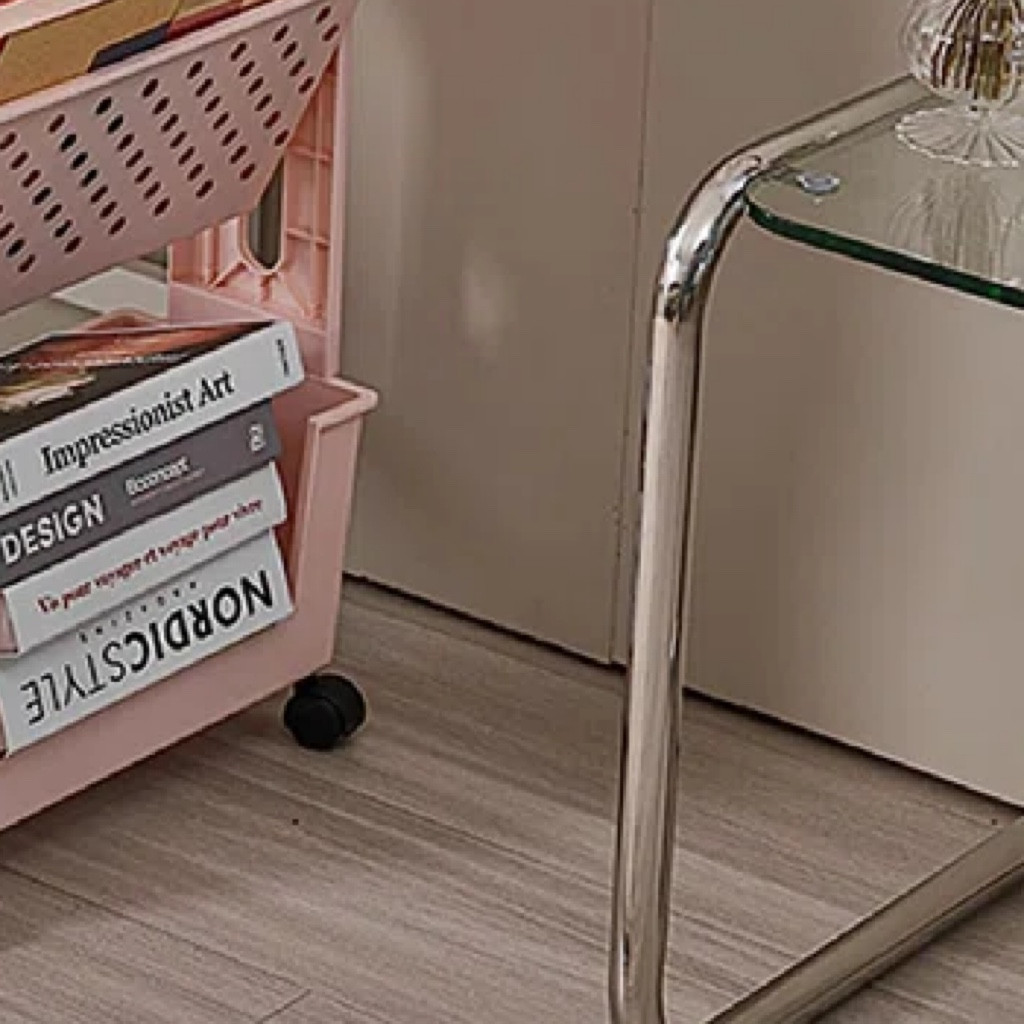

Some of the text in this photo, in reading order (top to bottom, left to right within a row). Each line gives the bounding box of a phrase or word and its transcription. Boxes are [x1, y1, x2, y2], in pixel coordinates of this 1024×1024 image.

[41, 386, 194, 476] Impressionist
[198, 370, 234, 410] Art
[0, 494, 104, 566] DESIGN
